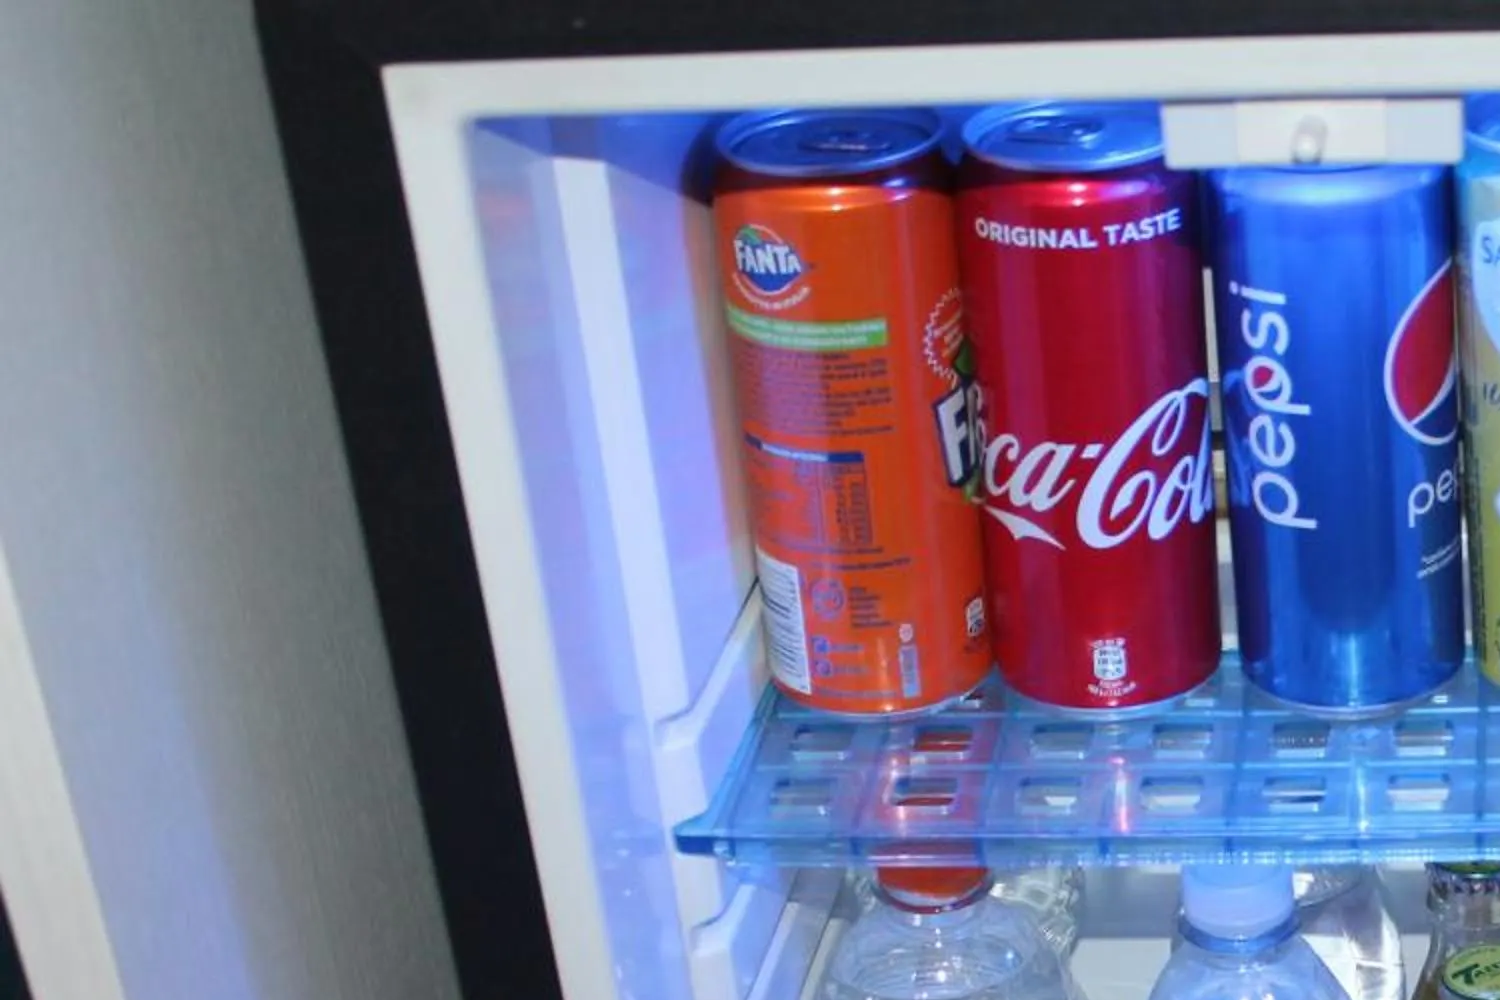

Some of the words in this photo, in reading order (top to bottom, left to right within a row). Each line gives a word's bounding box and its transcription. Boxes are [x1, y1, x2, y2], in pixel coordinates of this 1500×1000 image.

[733, 238, 801, 275] FANTA
[975, 217, 1098, 249] ORIGINAL
[1103, 208, 1181, 246] TASTE
[1229, 281, 1318, 529] pepsi
[984, 377, 1213, 550] ca-Col
